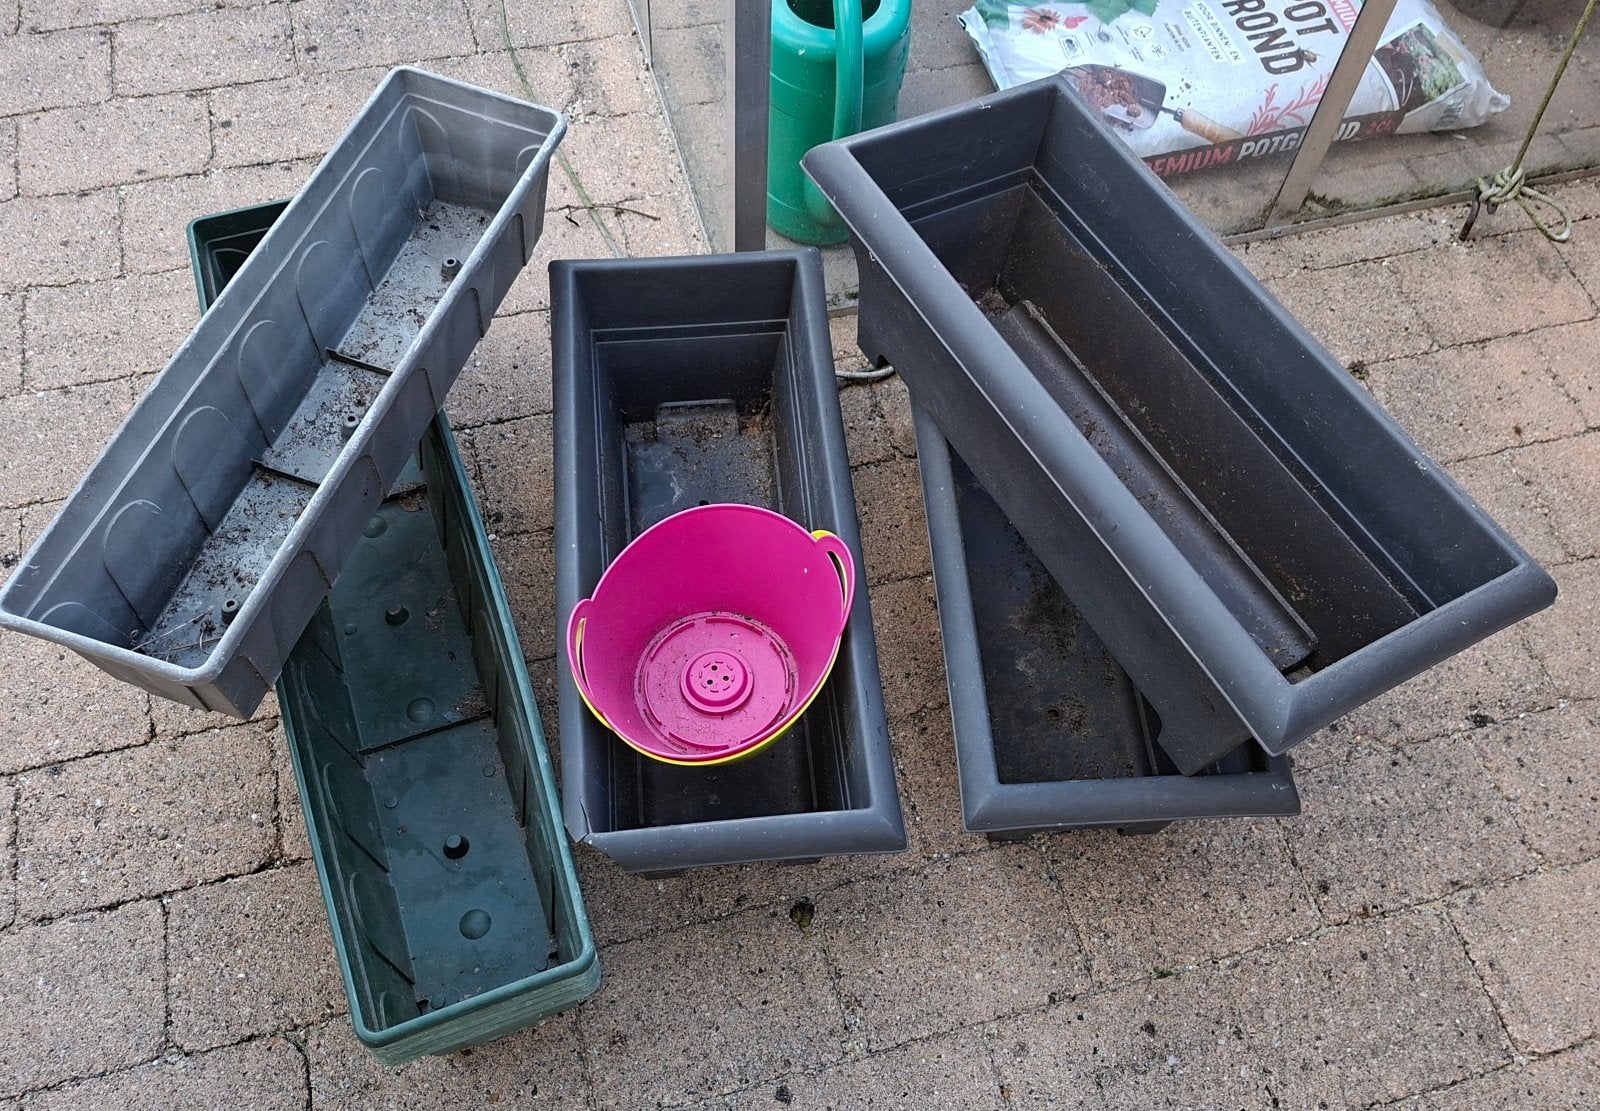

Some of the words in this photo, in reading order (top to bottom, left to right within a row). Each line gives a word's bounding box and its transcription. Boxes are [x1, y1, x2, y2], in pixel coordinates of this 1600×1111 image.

[1197, 2, 1214, 20] VOOR
[1230, 50, 1242, 61] EN
[1222, 0, 1305, 75] ROND
[1283, 0, 1339, 36] OT
[1236, 121, 1361, 161] POTGD
